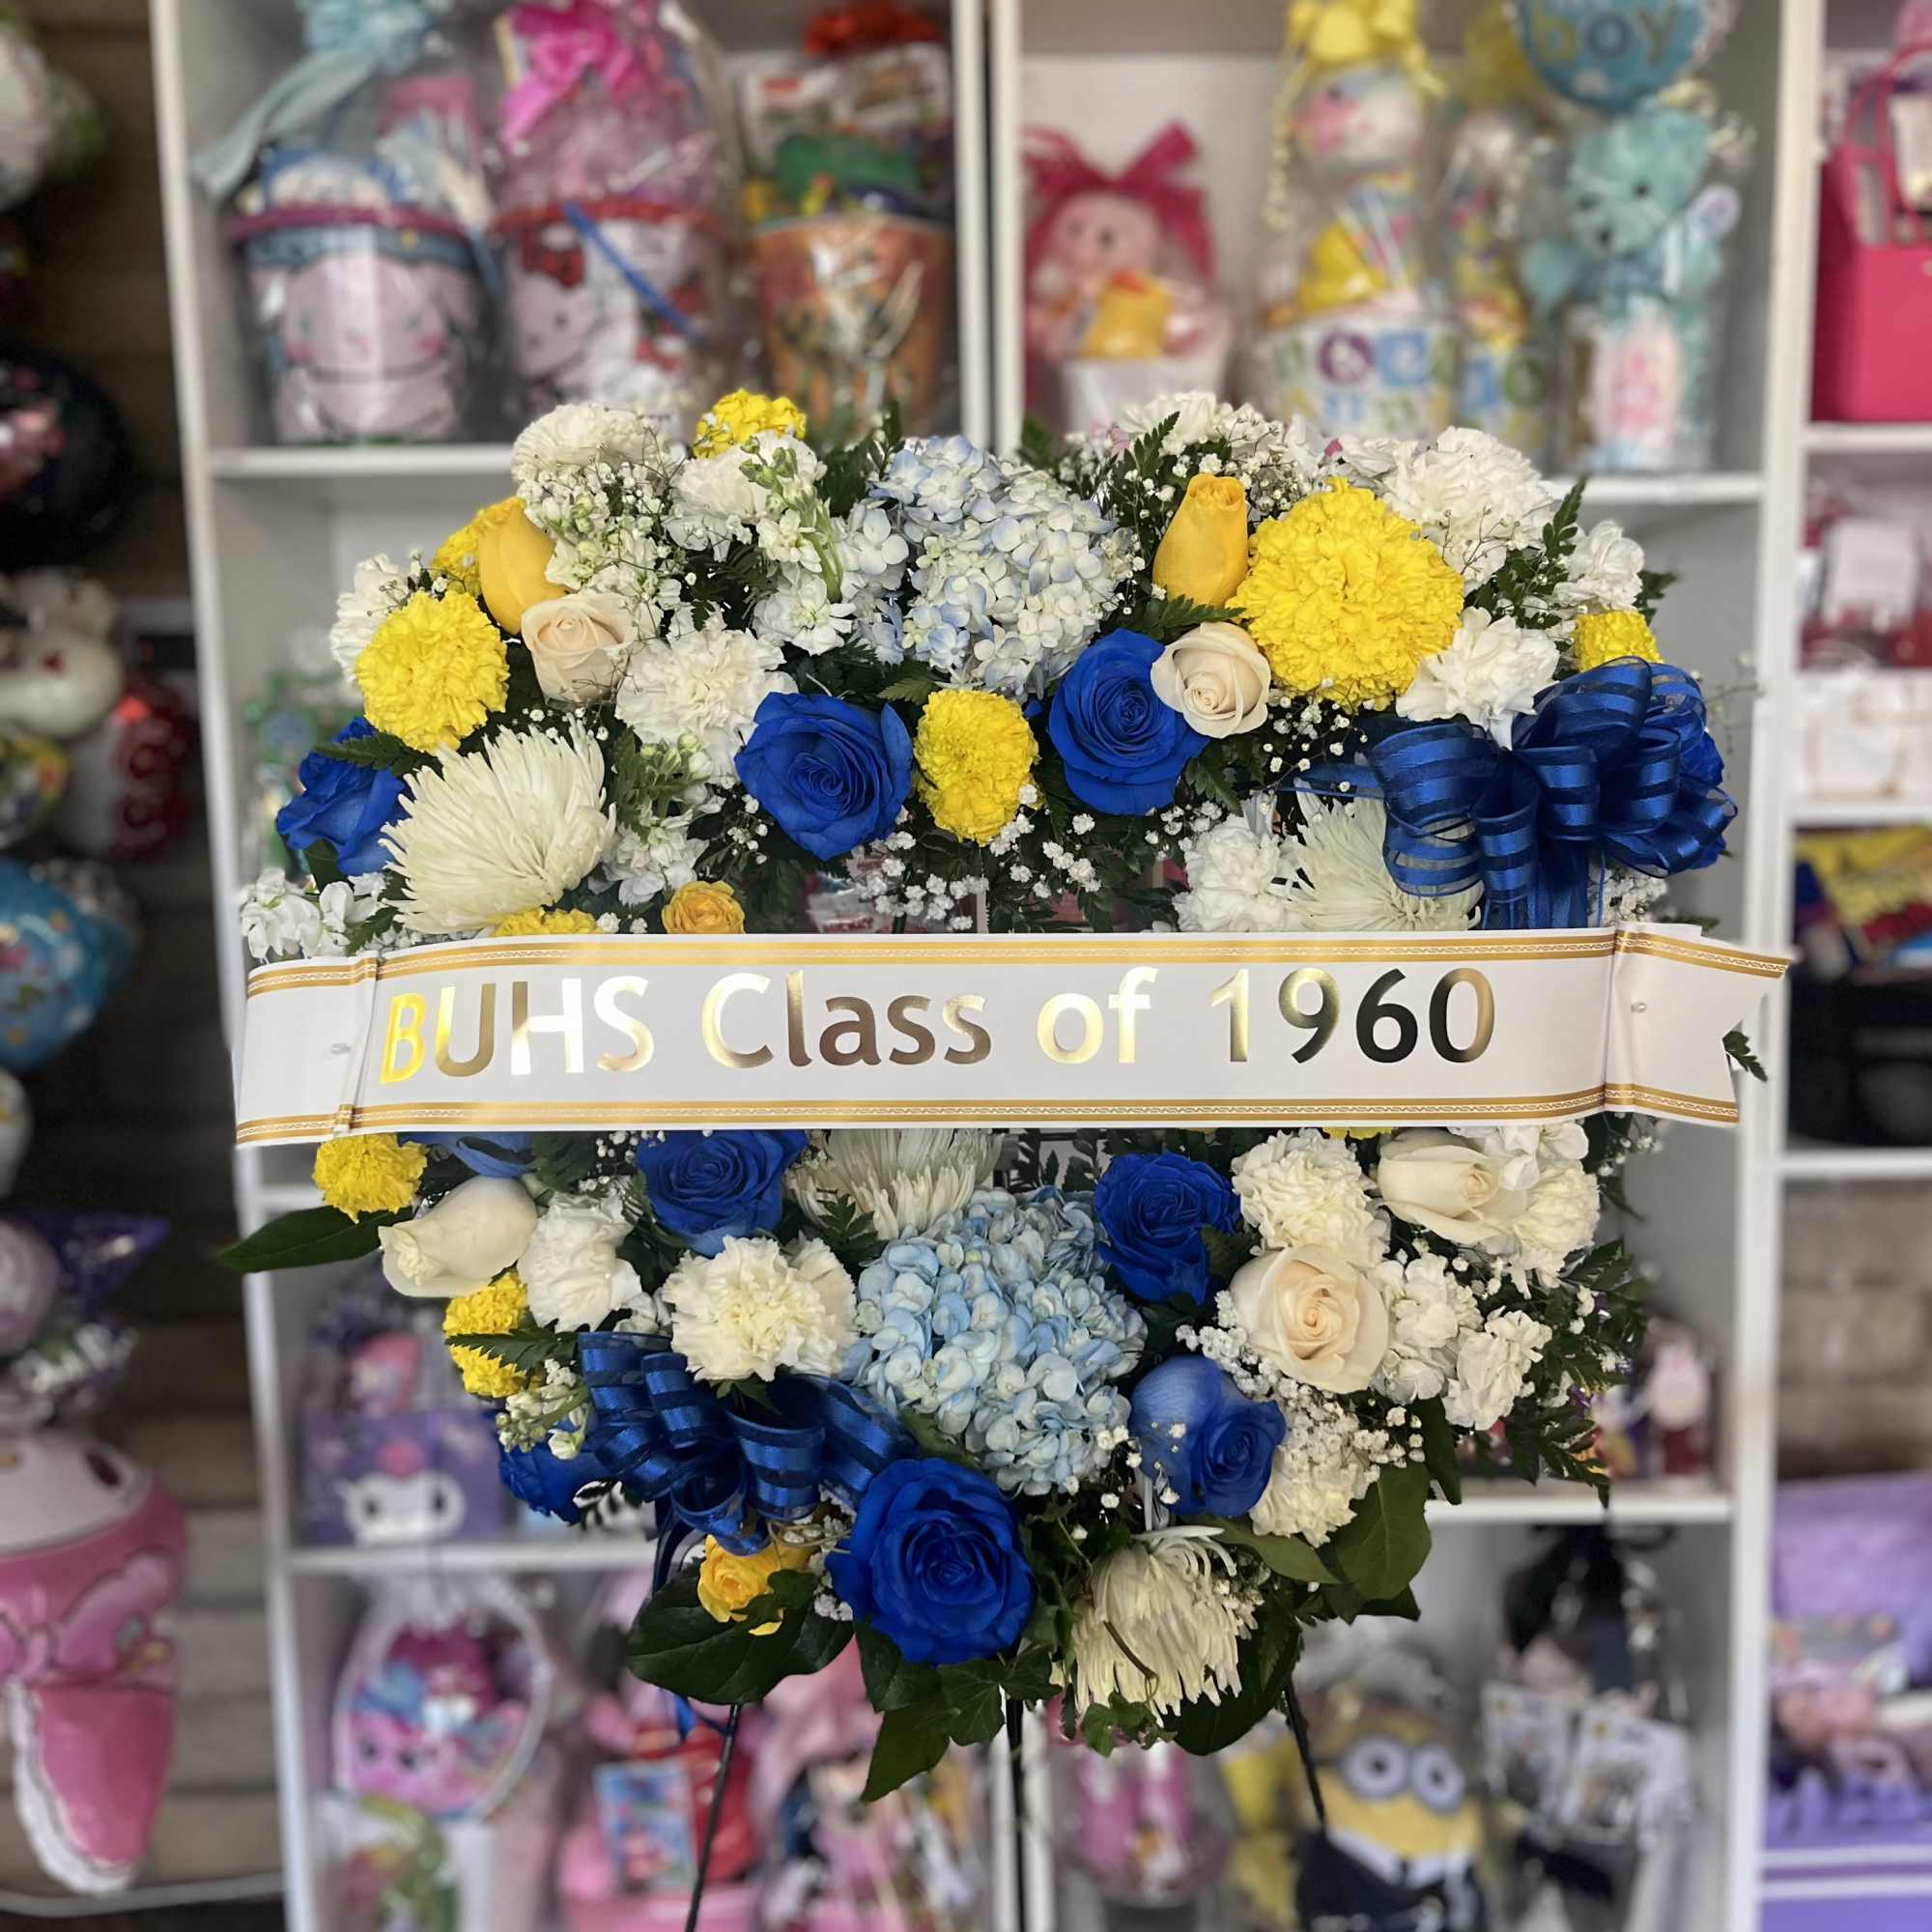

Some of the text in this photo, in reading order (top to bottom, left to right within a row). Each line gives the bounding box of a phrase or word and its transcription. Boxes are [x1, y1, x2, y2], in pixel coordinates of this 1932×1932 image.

[379, 966, 1495, 1084] BUHS Class of 1960
